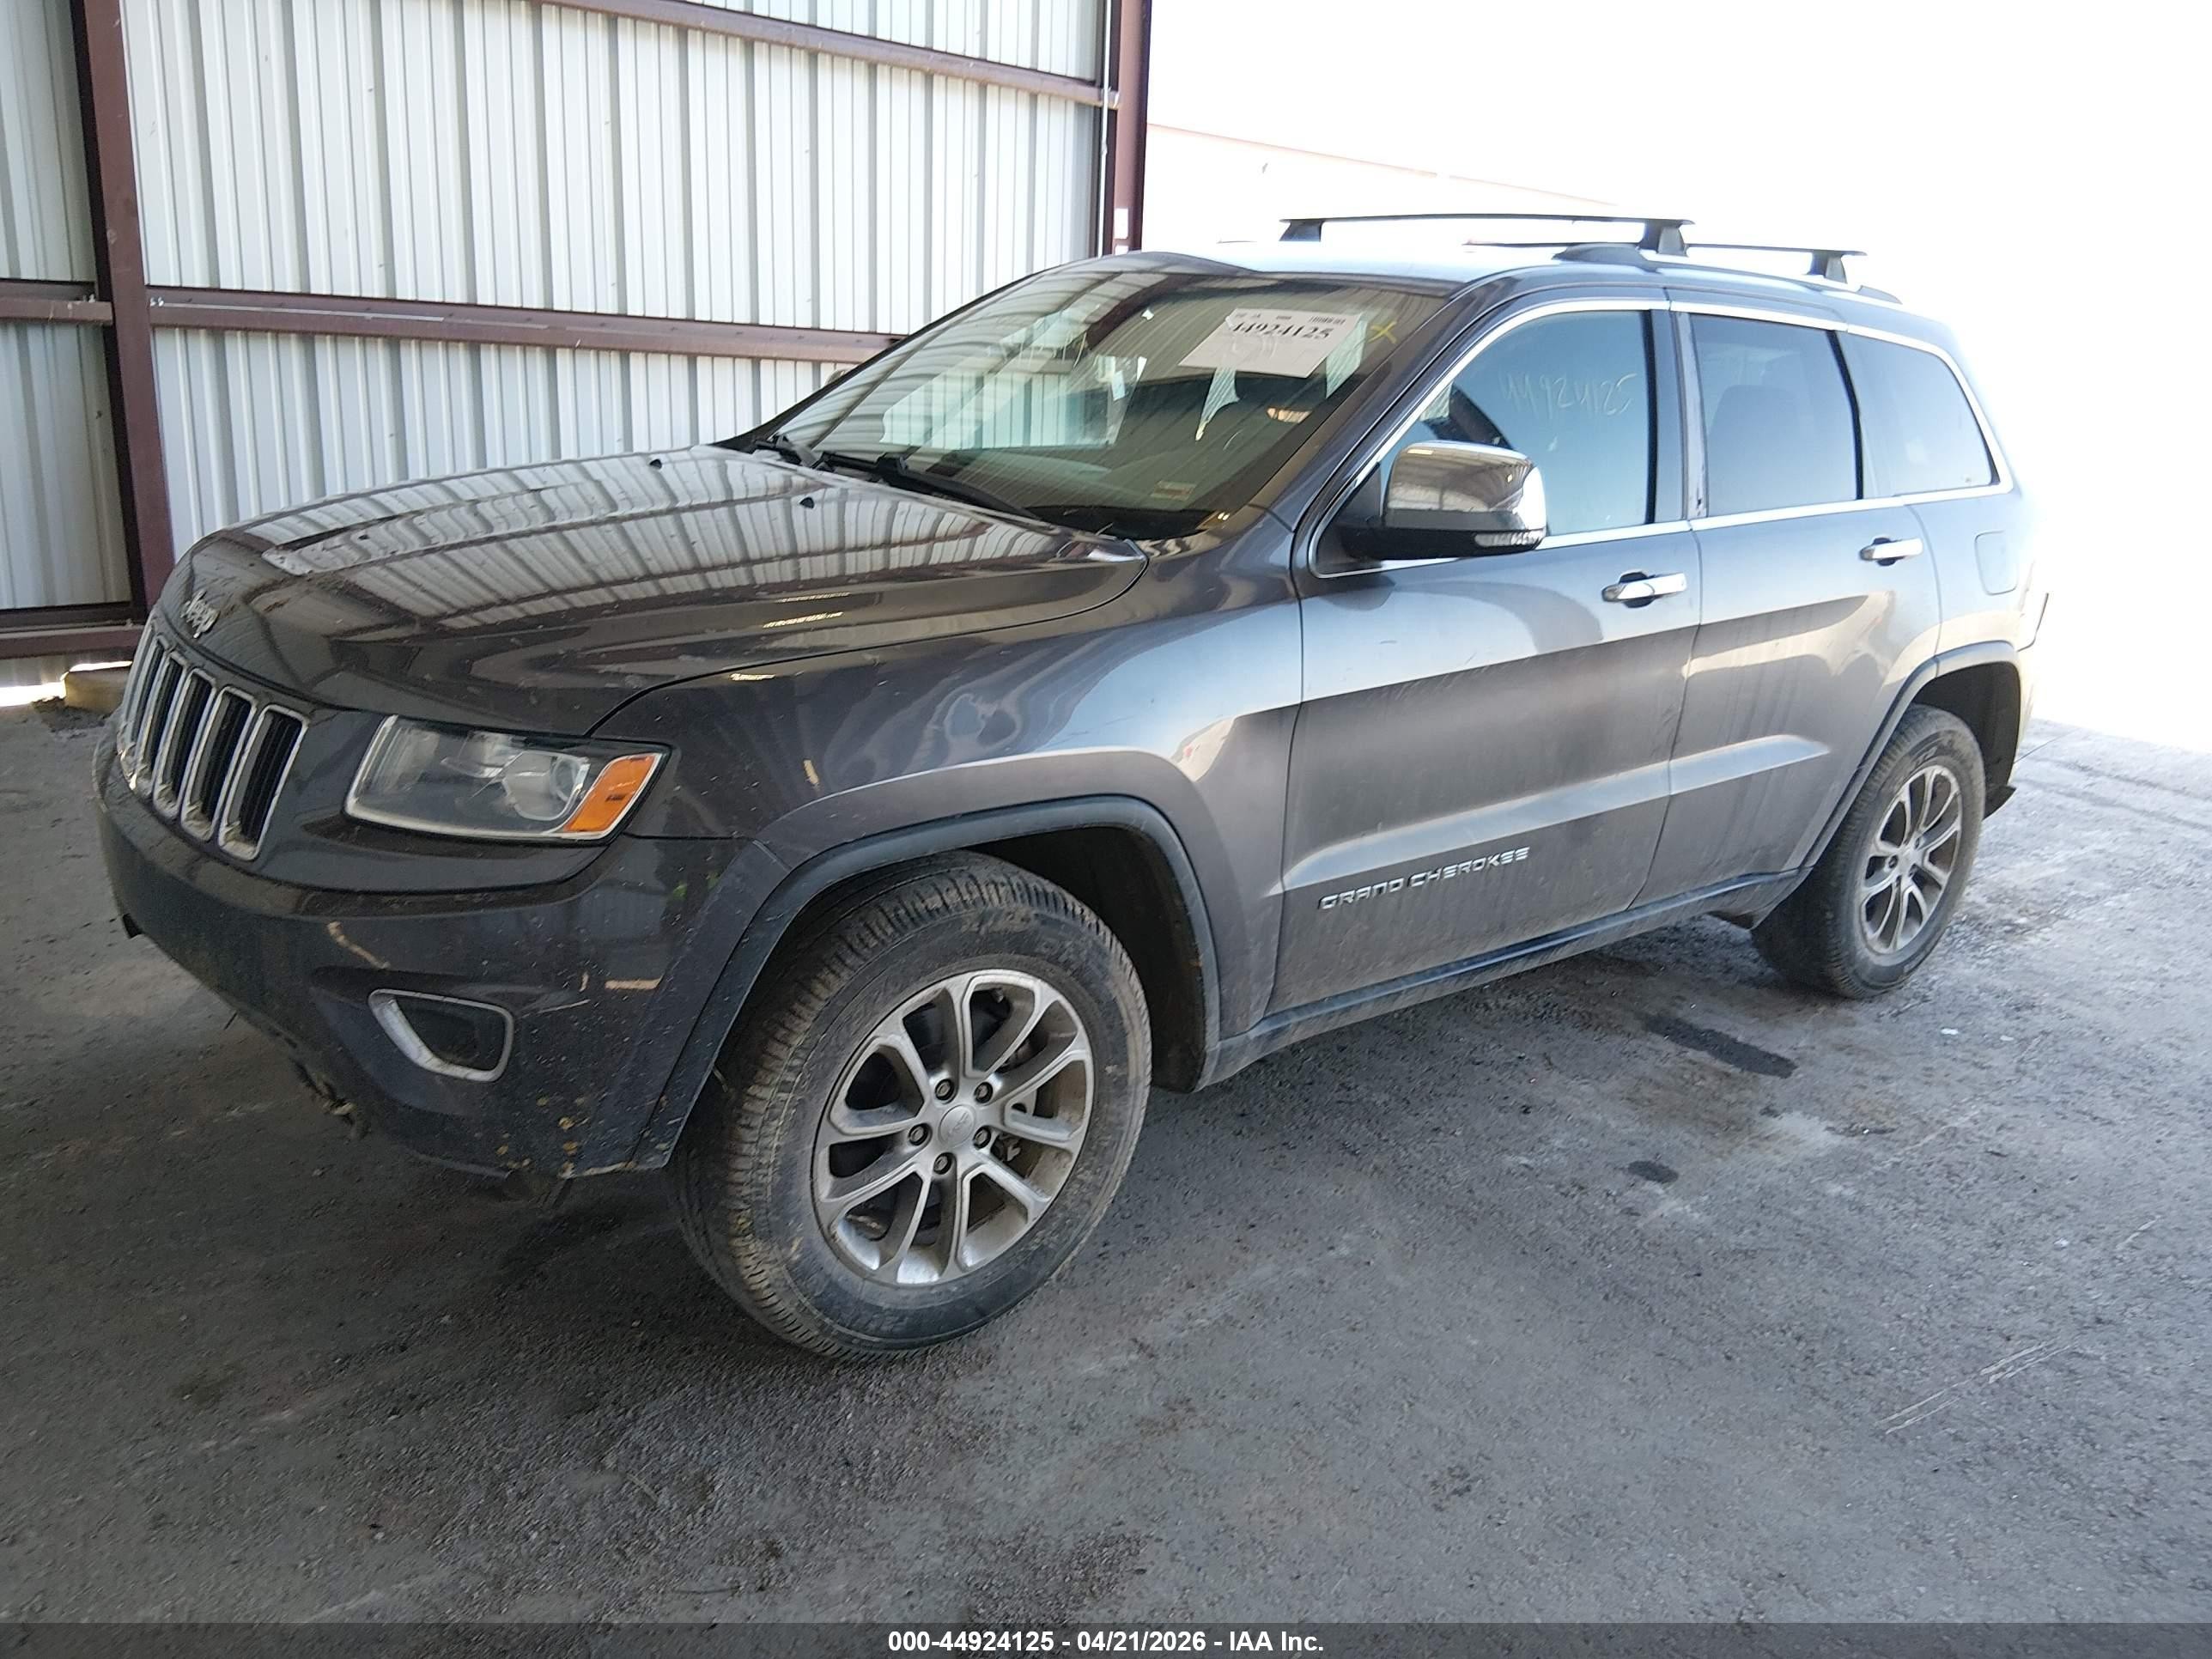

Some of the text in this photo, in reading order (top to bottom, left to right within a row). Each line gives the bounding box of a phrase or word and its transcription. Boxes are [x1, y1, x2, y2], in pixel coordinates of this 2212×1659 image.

[1233, 321, 1334, 338] 44924125
[1318, 846, 1530, 909] GRAND CHEROKEE
